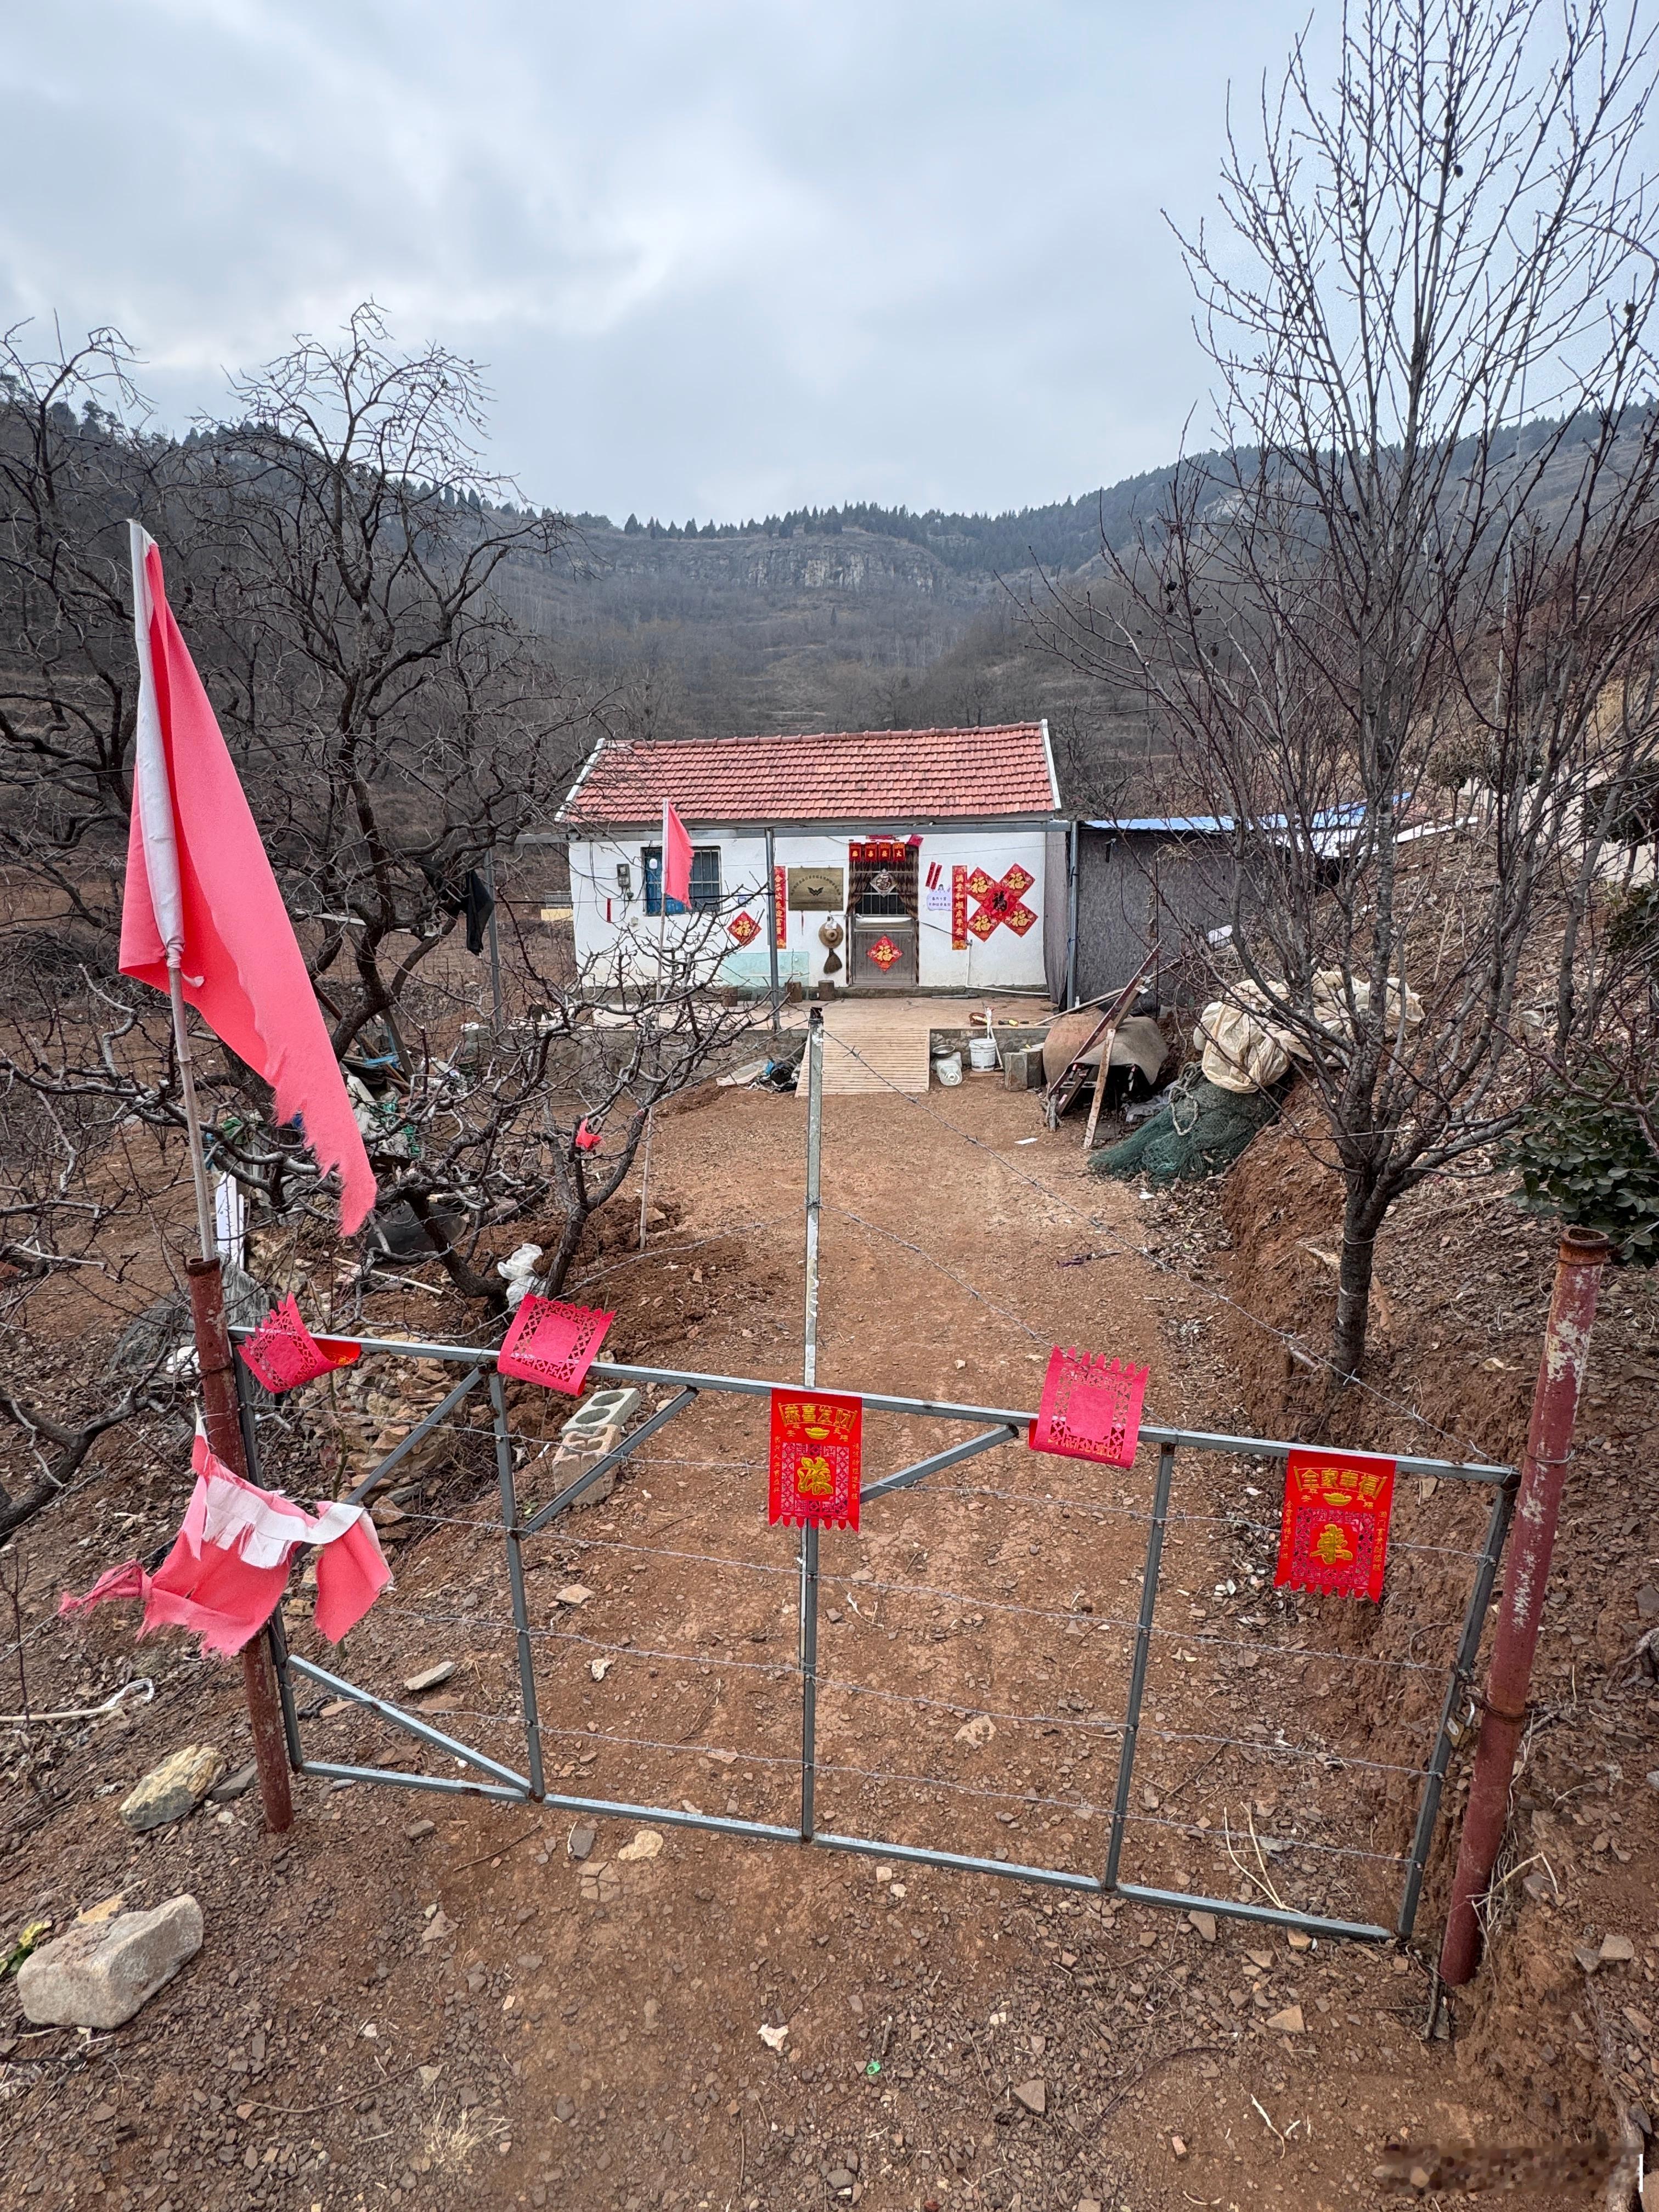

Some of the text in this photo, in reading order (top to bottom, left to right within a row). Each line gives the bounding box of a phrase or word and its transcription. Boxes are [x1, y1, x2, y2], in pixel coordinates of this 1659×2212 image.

[970, 876, 990, 893] 福
[1007, 872, 1026, 889] 福
[992, 890, 1007, 911] 福
[973, 915, 992, 932] 福
[1011, 910, 1030, 927] 福
[735, 921, 751, 936] 福
[874, 945, 894, 961] 福
[785, 1404, 850, 1427] 恭喜发财
[1302, 1469, 1380, 1496] 全家幸福
